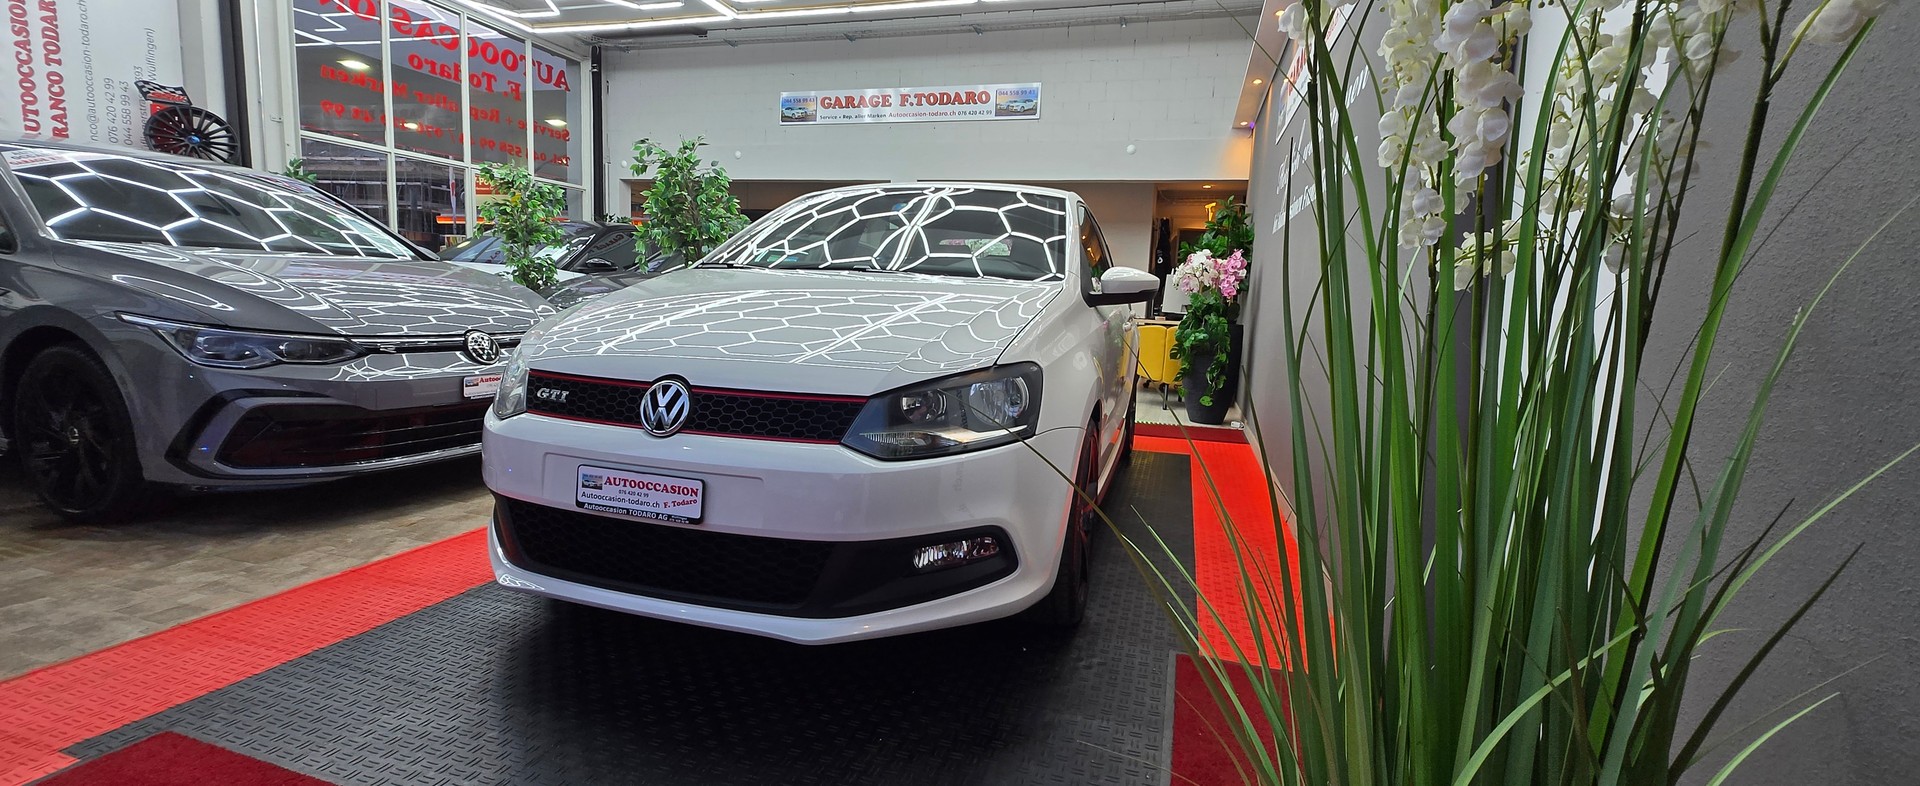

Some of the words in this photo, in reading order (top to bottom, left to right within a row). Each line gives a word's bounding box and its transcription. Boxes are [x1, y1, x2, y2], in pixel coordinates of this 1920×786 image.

[38, 0, 62, 67] TODAR
[8, 0, 42, 135] UTOOCCASIO
[78, 0, 100, 142] nco@autooccasion-todaro.ch
[103, 77, 114, 90] 99
[119, 80, 129, 93] 43
[46, 70, 69, 139] RANCO
[104, 92, 115, 104] 42
[120, 94, 130, 107] 99
[820, 95, 892, 110] GARAGE
[900, 90, 991, 107] F.TODARO
[106, 106, 117, 124] 420
[121, 108, 132, 125] 558
[888, 110, 957, 118] Autooccasion-todaro.ch
[108, 126, 119, 144] 076
[123, 127, 133, 146] 044
[536, 387, 569, 403] GTI
[640, 380, 690, 437] VW
[604, 476, 699, 497] AUTOOCCASION
[581, 491, 660, 509] Autooccasion-todaro.ch
[671, 499, 698, 507] Todaro
[583, 502, 627, 515] Autooccasion
[629, 509, 657, 519] TODARO
